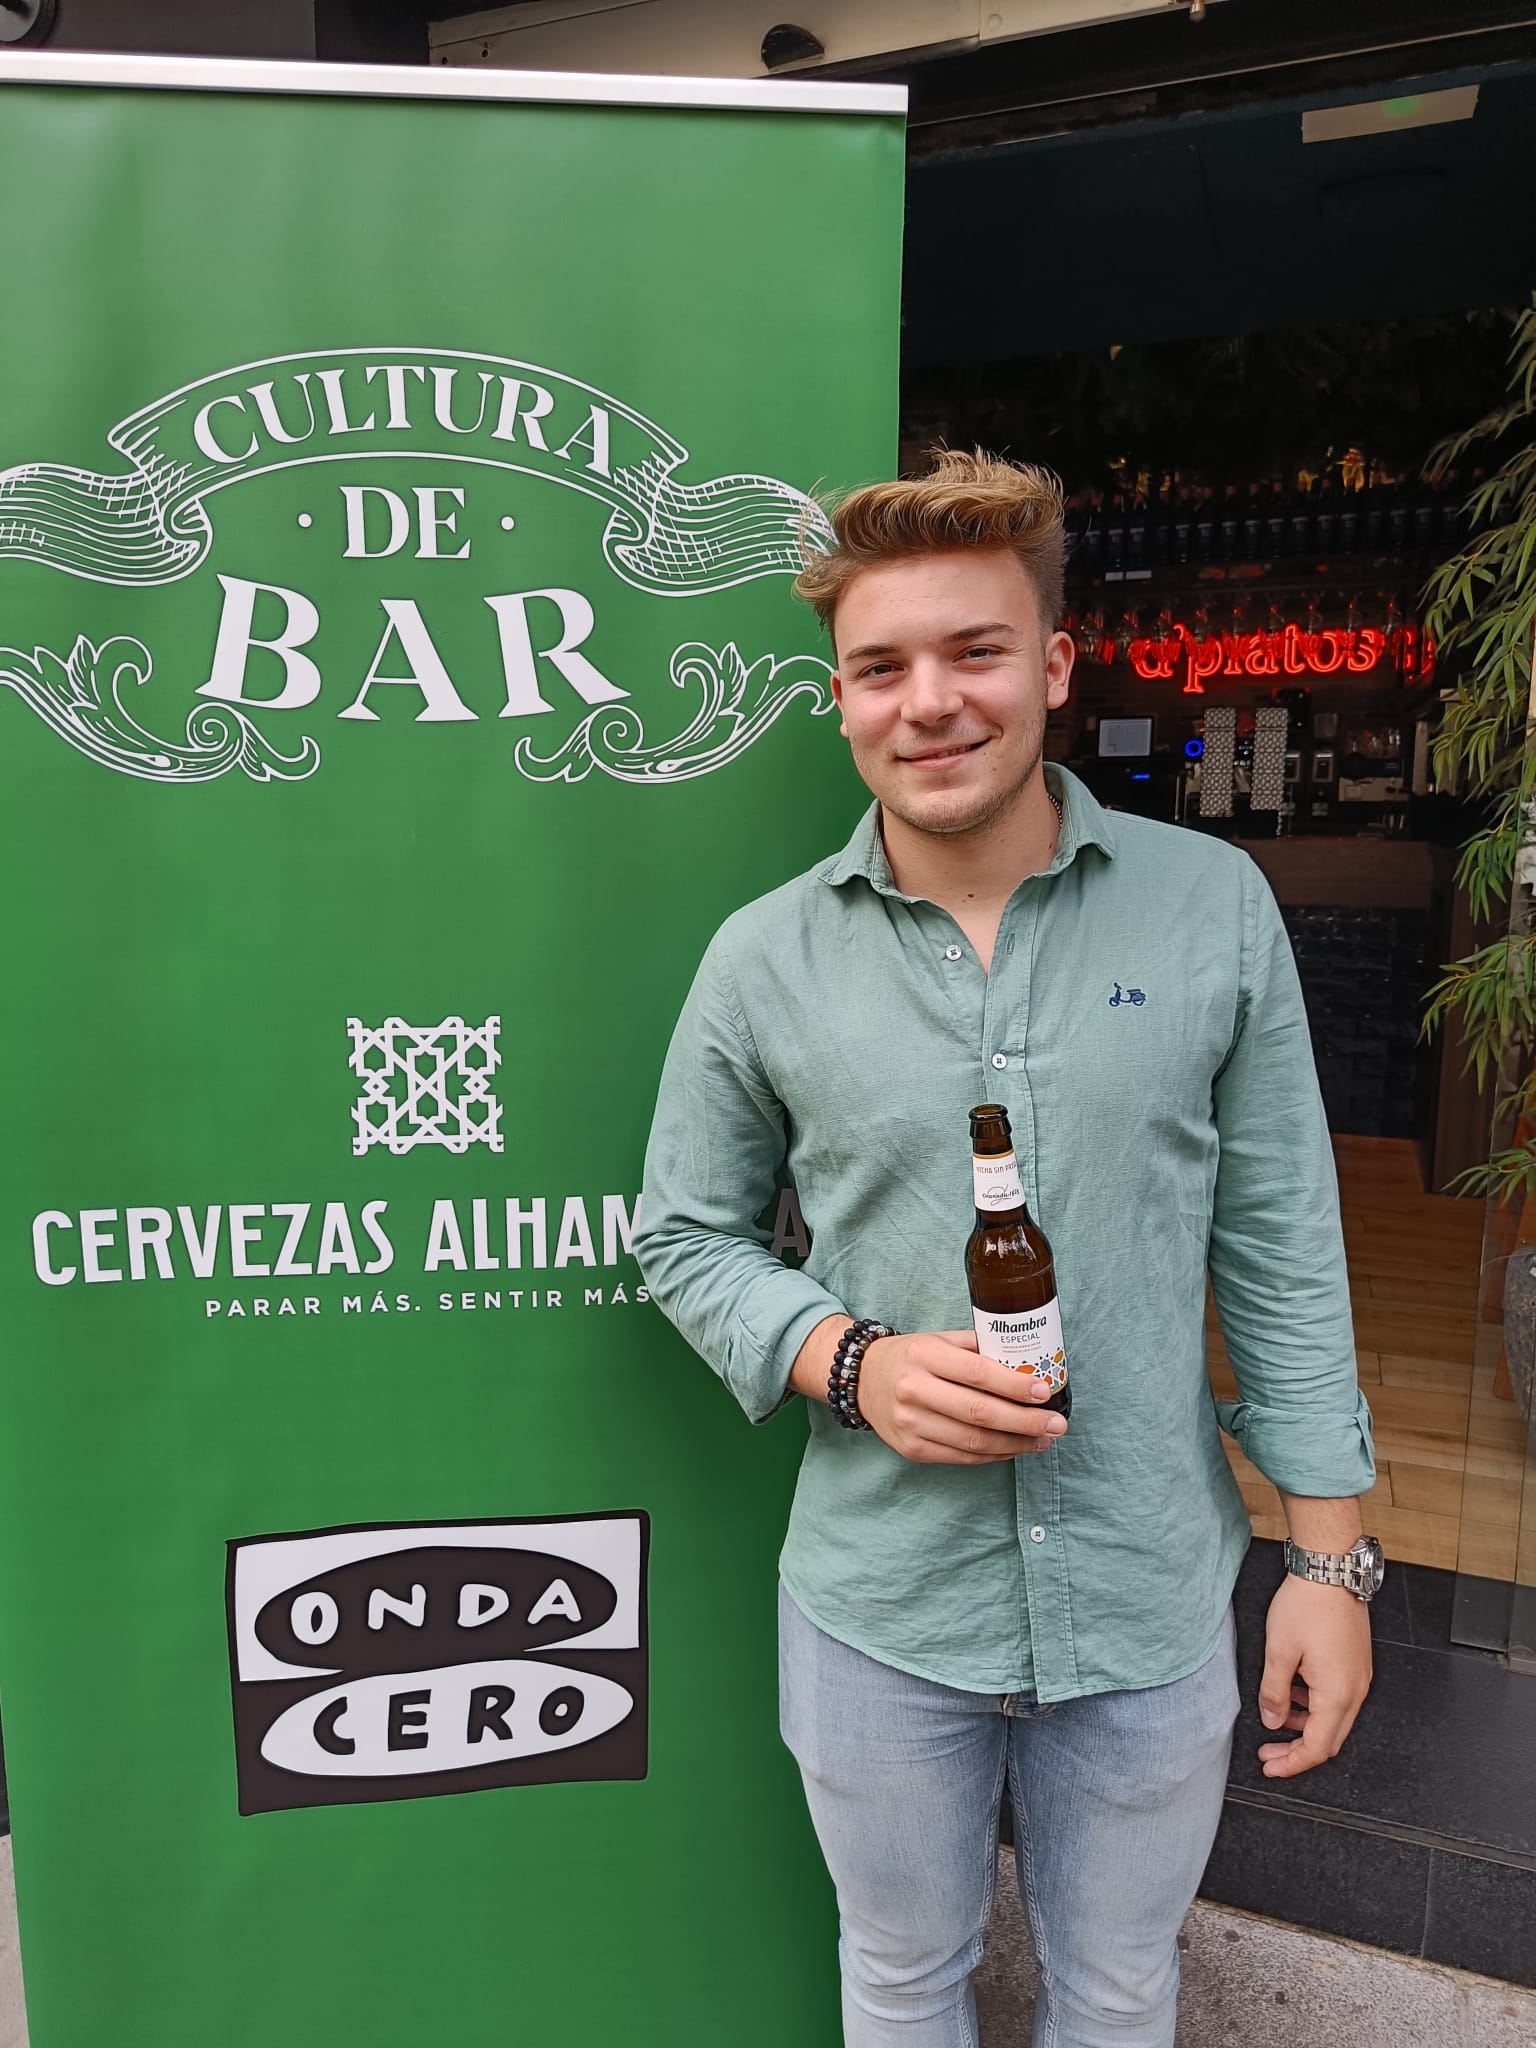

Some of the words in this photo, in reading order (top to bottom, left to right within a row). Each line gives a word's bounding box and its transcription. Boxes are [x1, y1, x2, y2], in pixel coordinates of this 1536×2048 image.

[193, 365, 612, 480] CULTURA
[340, 486, 471, 559] DE
[195, 573, 632, 723] BAR
[32, 1200, 394, 1286] CERVEZAS
[206, 1297, 321, 1318] PARAR
[342, 1289, 422, 1313] MÁS.
[439, 1289, 563, 1310] SENTIR
[988, 1316, 1047, 1334] Alhambra
[1001, 1332, 1041, 1344] ESPECIAL
[289, 1578, 582, 1645] ONDA
[313, 1685, 585, 1756] CERO
